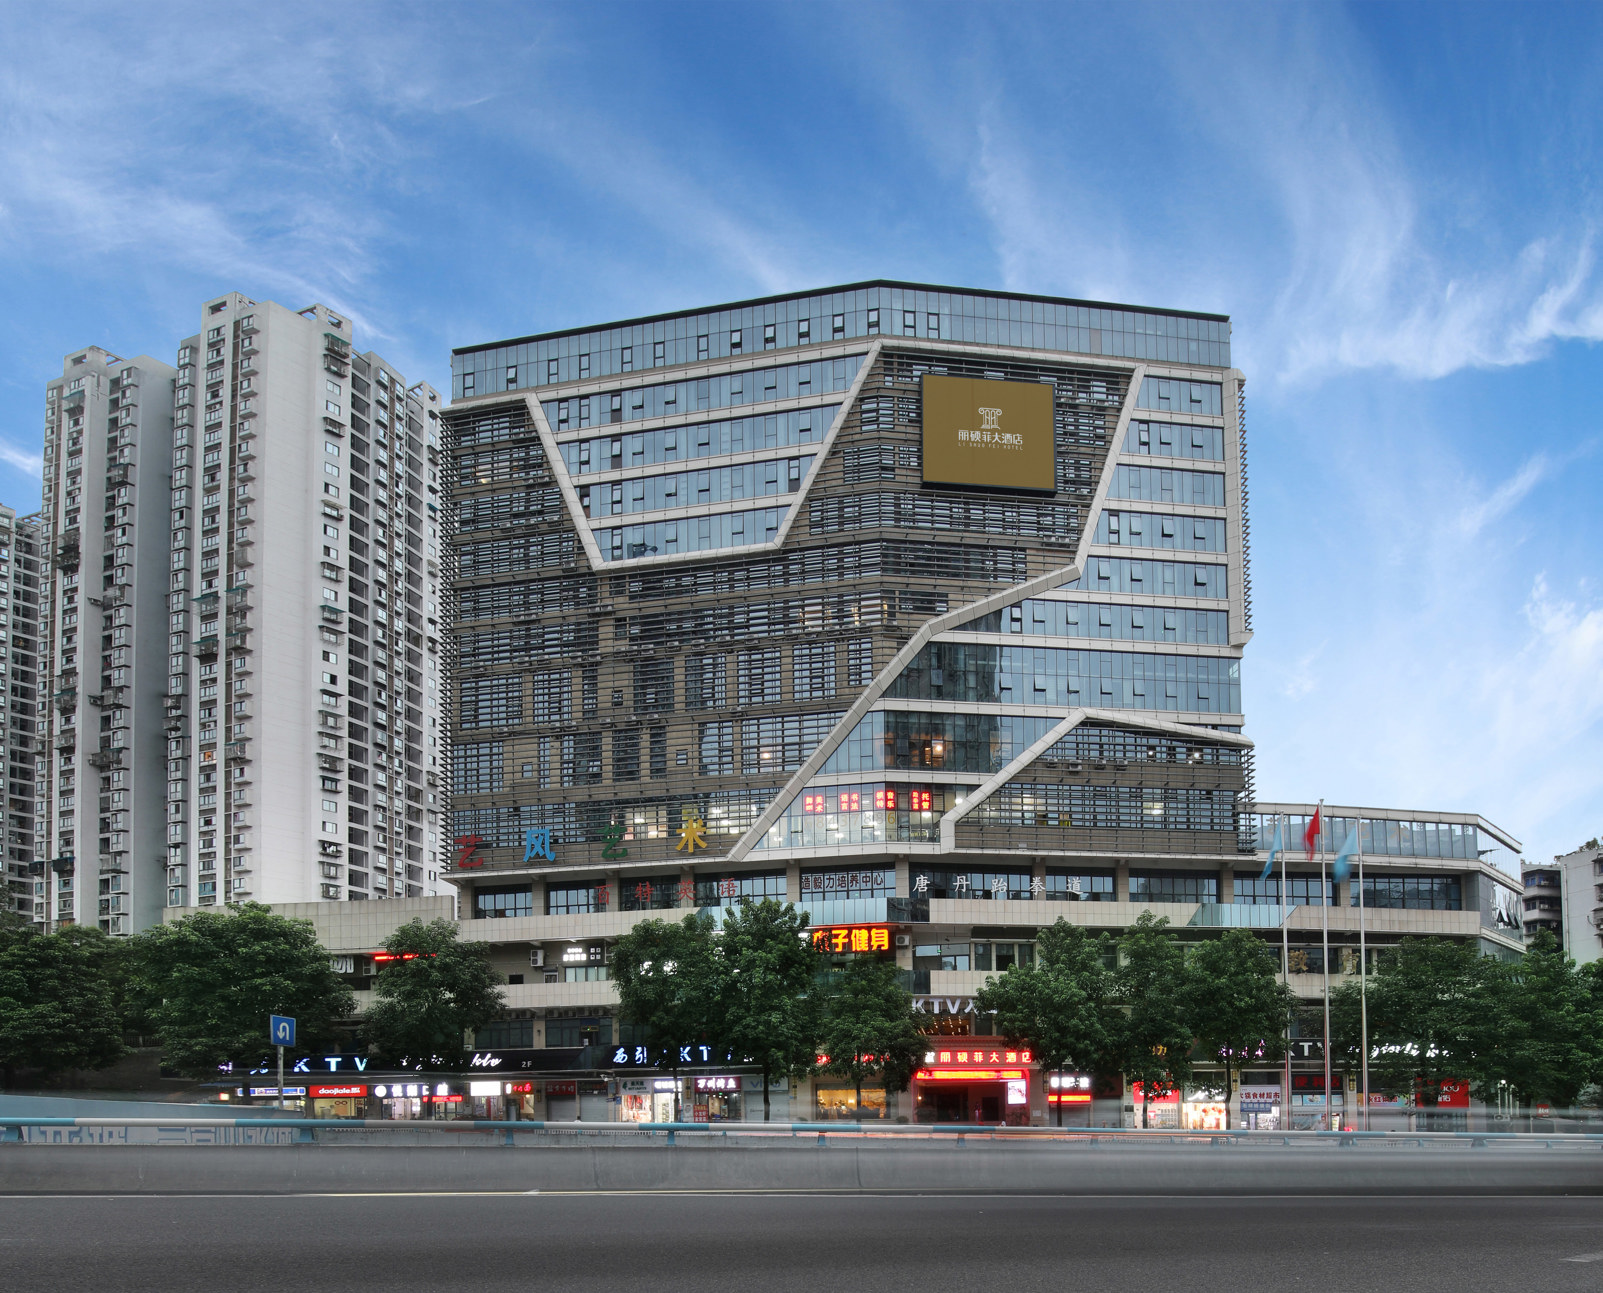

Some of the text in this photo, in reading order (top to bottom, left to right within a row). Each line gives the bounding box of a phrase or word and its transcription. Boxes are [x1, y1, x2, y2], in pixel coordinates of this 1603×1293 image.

[958, 429, 1023, 445] 丽硕菲大酒店
[886, 790, 895, 809] 音乐
[921, 791, 930, 811] 托管
[454, 818, 708, 868] 艺风艺术
[594, 877, 738, 905] 百特英语
[912, 874, 1083, 894] 唐丹跆拳道
[293, 1057, 369, 1073] KTV
[940, 1051, 1032, 1063] 丽硕菲大酒店
[318, 1086, 350, 1095] daojiale
